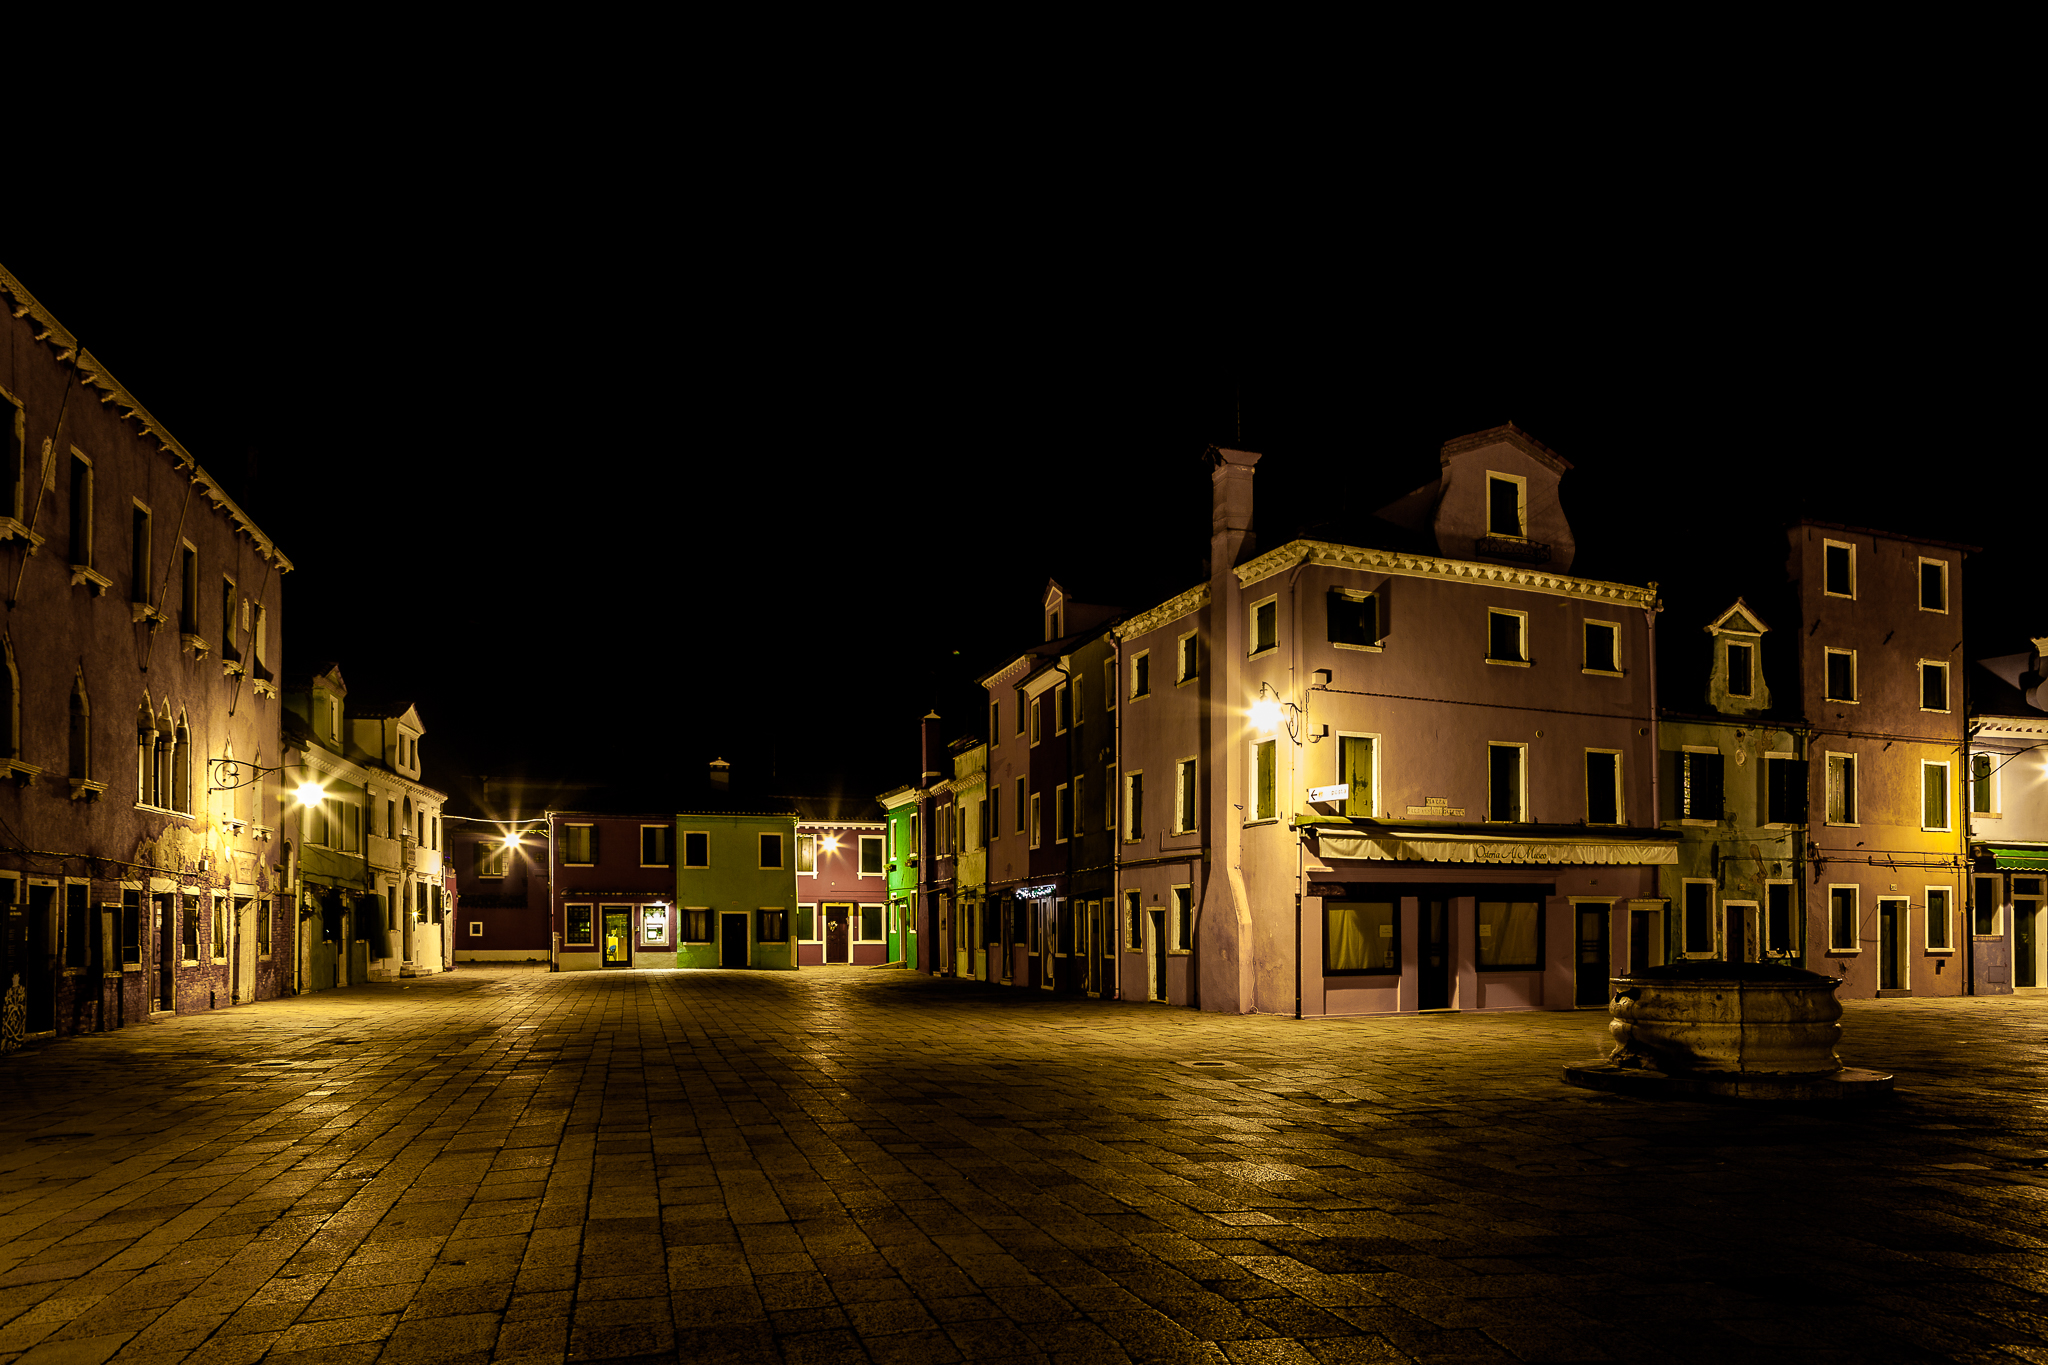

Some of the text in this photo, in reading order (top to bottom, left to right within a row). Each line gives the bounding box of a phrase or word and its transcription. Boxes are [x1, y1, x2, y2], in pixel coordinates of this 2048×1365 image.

[1476, 845, 1547, 859] Osteria Al Museo
